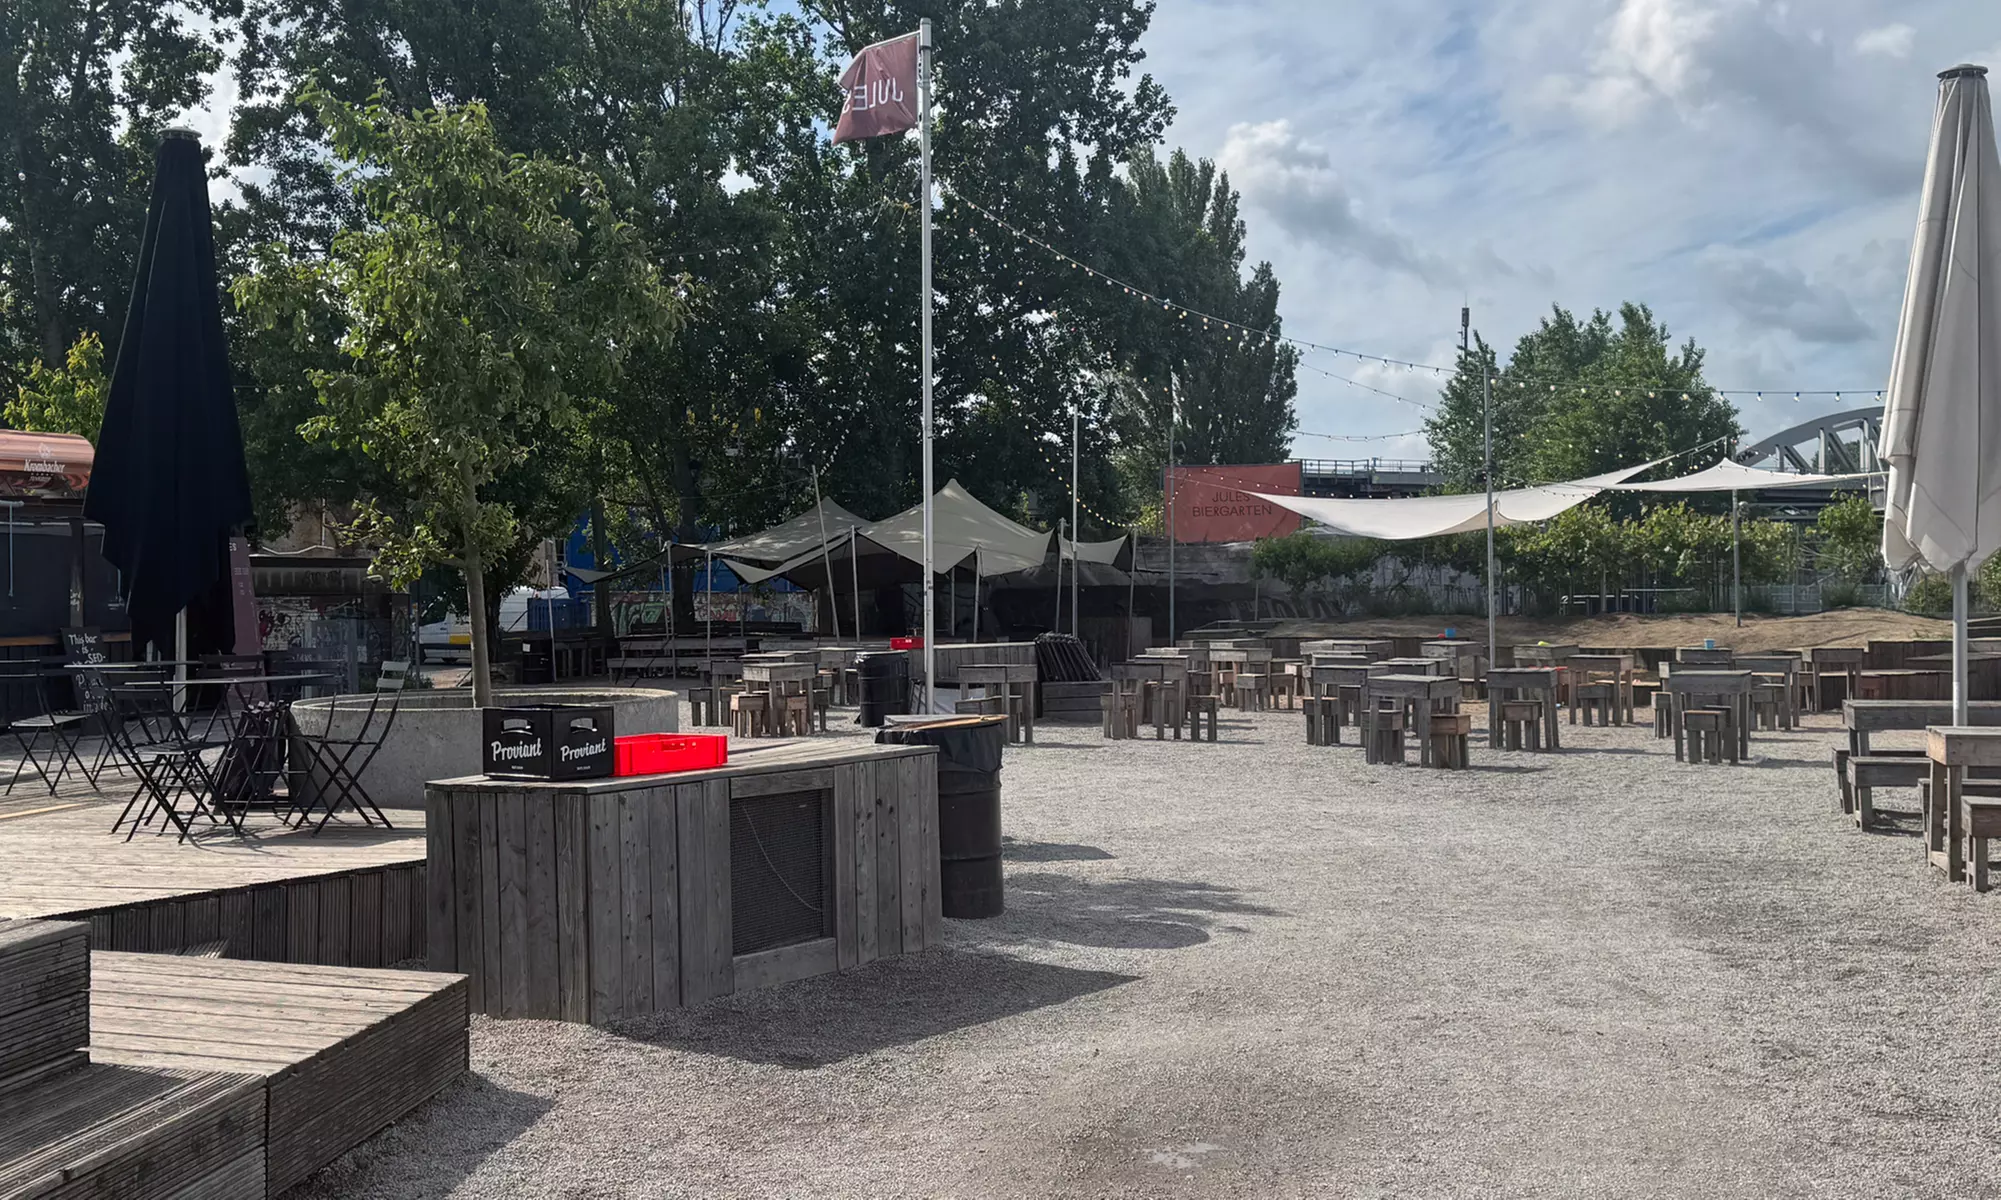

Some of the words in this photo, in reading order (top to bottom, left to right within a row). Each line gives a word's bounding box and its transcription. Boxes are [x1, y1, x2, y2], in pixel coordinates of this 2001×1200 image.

[1212, 492, 1250, 503] JULES
[1192, 505, 1272, 517] BIERGARTEN
[68, 634, 84, 645] This
[491, 738, 542, 761] Proviant
[560, 738, 606, 762] Proviant
